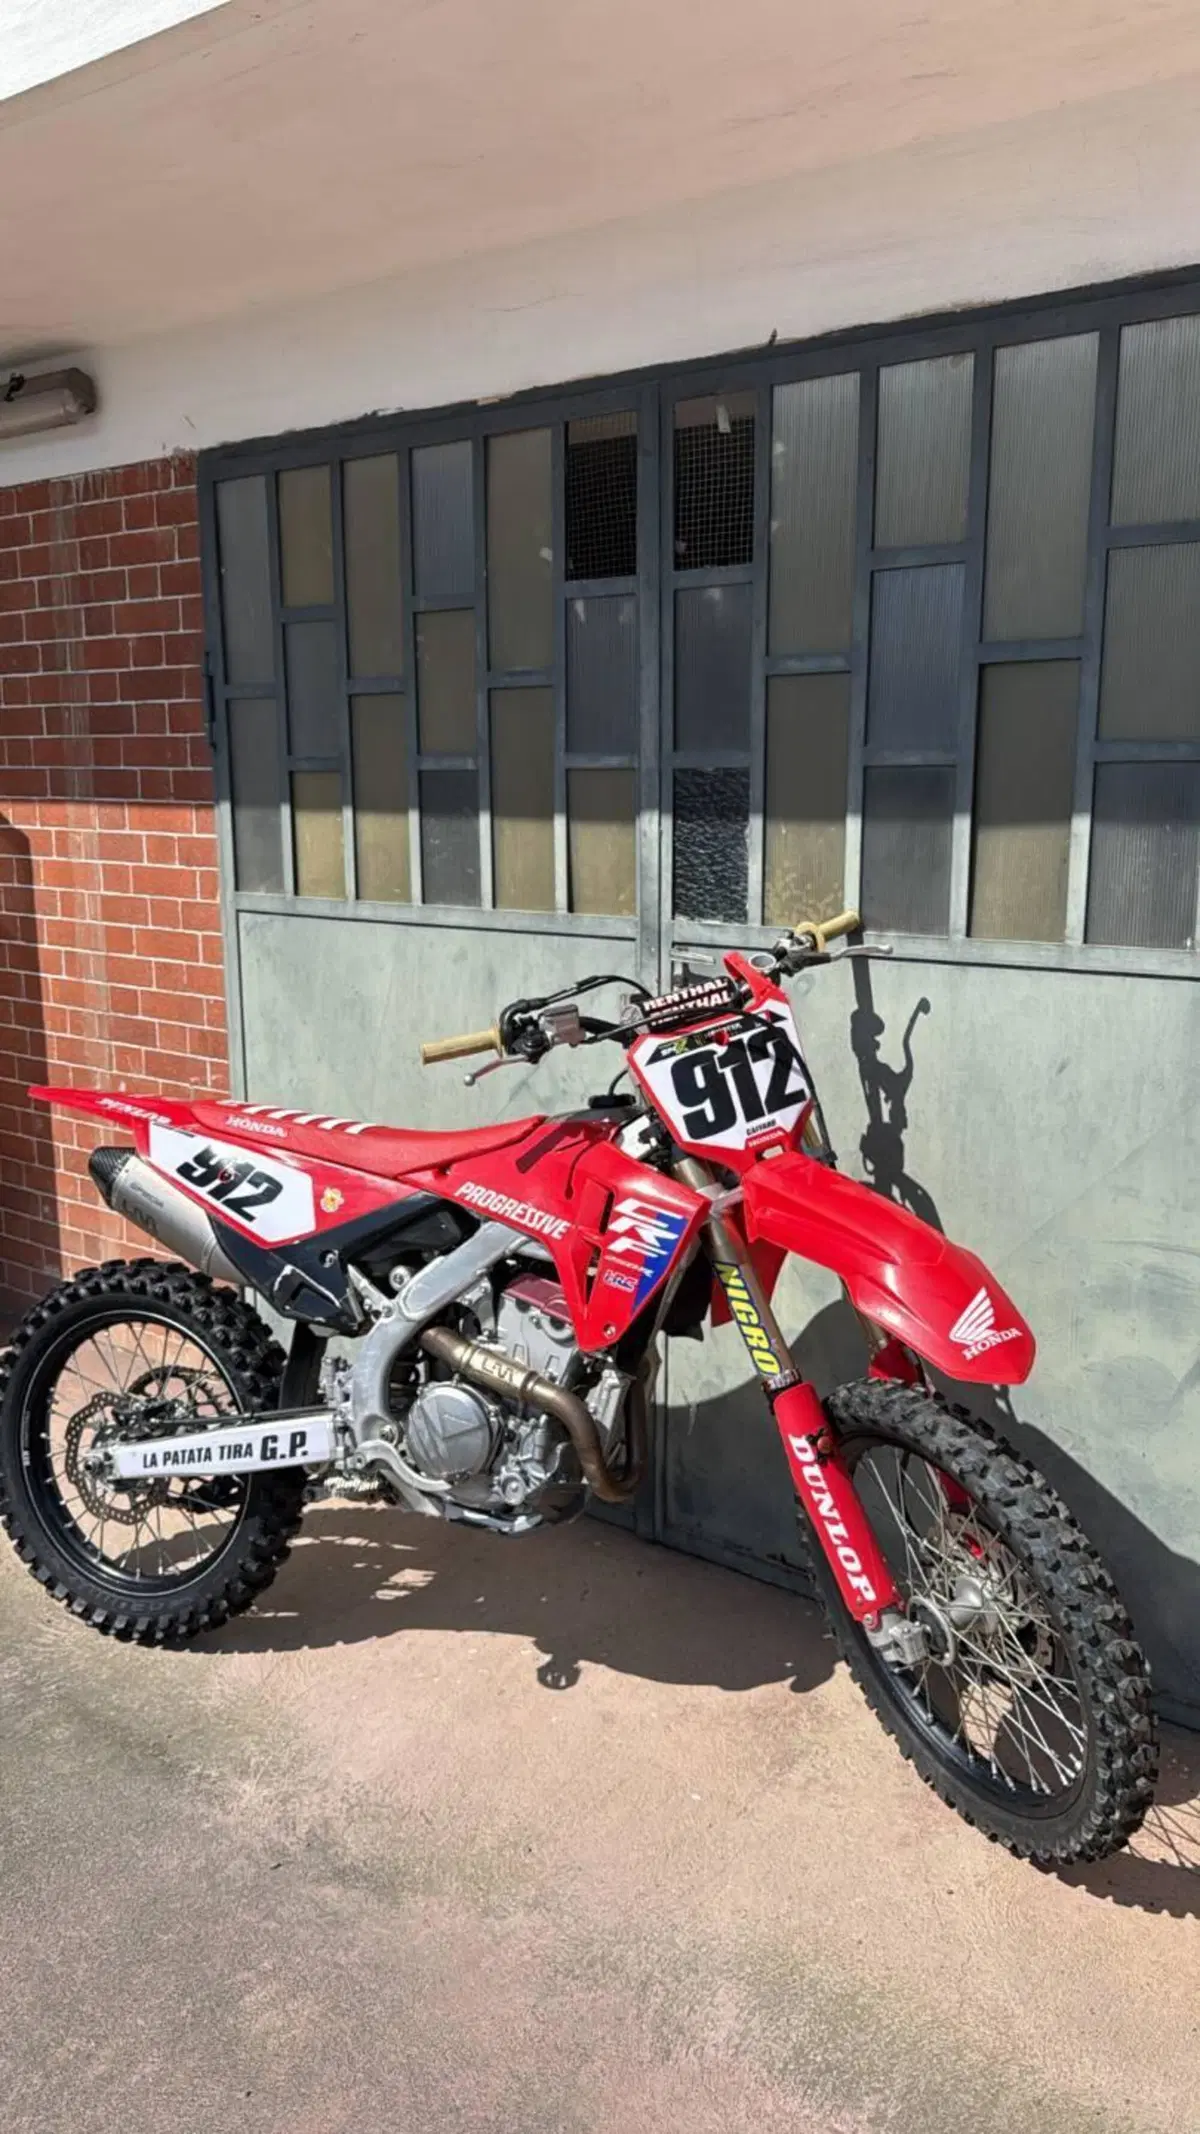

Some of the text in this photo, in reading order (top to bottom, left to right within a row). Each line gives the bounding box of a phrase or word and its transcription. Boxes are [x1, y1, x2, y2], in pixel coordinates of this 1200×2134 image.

[671, 1026, 807, 1140] 912
[225, 1115, 287, 1137] HONDA
[176, 1145, 283, 1222] 912
[454, 1181, 571, 1240] PROGRESSIVE
[713, 1260, 782, 1376] NIGRO
[962, 1327, 1023, 1360] HONDA
[143, 1431, 308, 1469] LA PATATA TIRA G.P.
[787, 1433, 877, 1602] DUNLOP
